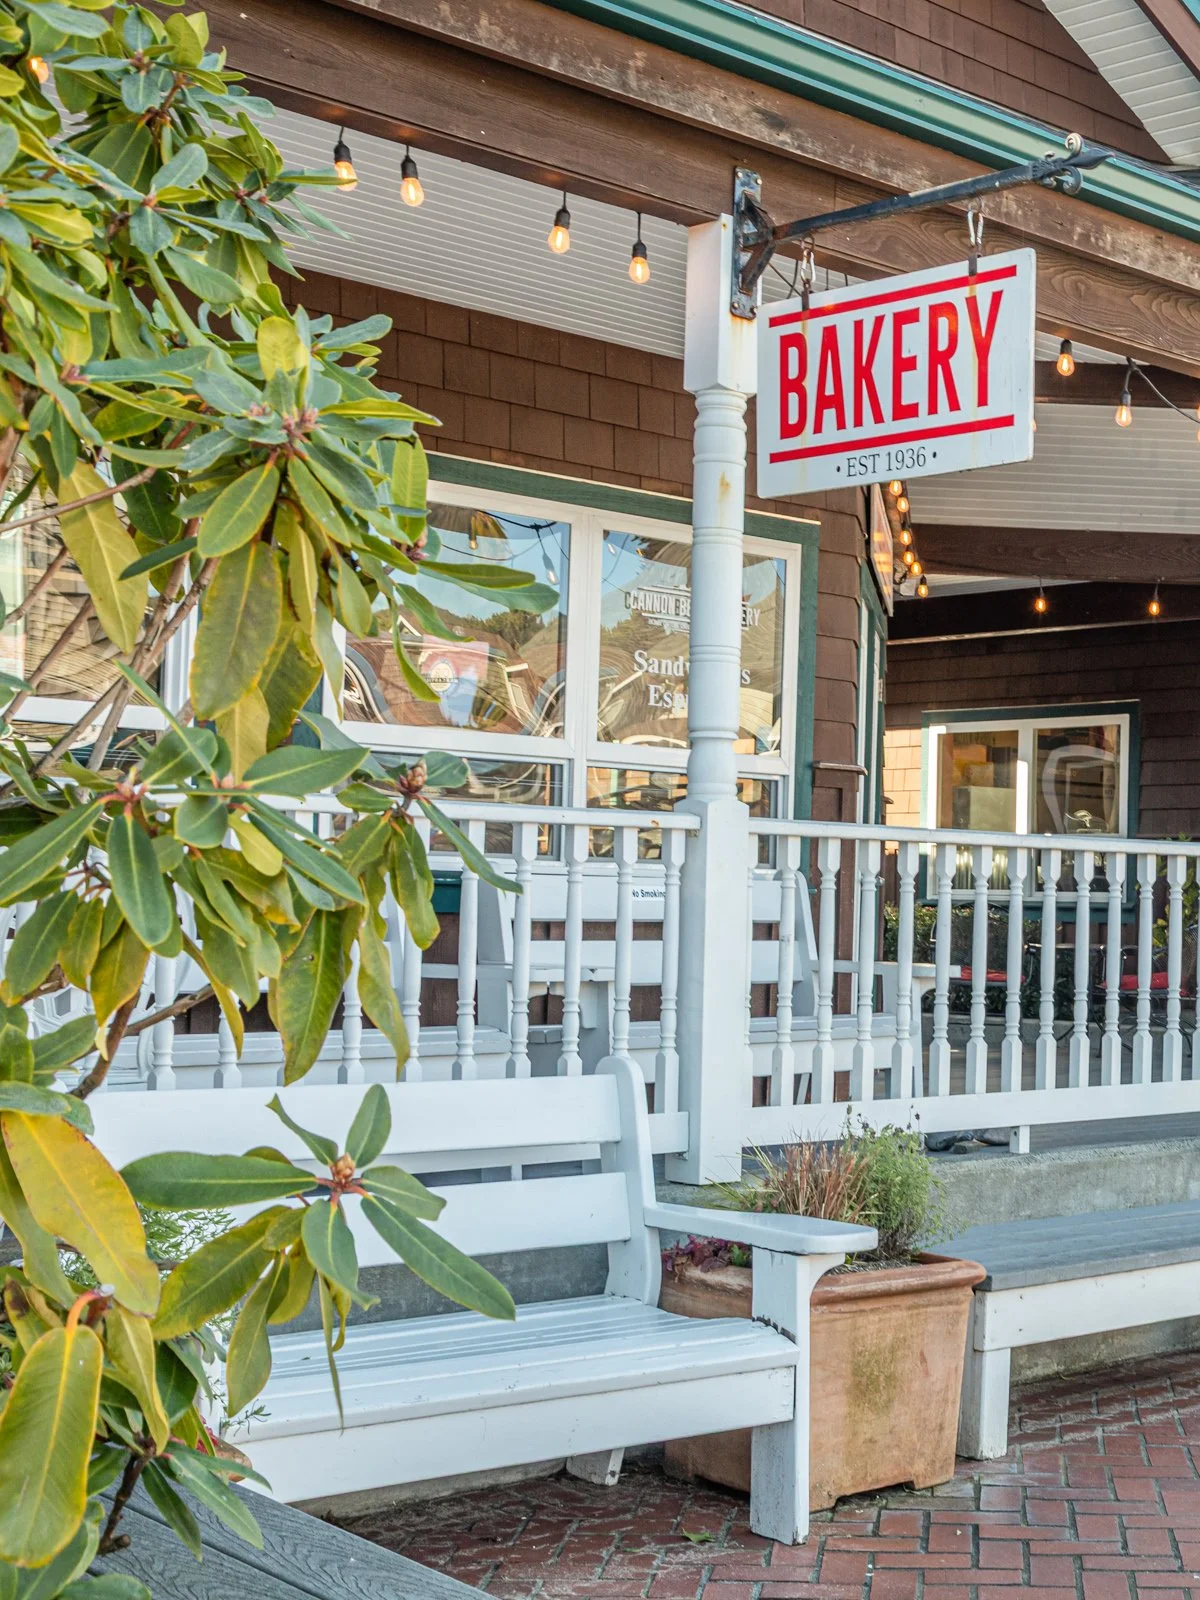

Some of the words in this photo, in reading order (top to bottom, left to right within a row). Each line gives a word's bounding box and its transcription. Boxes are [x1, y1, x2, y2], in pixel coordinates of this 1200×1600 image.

[780, 290, 1004, 440] BAKERY
[846, 453, 880, 477] EST
[886, 446, 927, 473] 1936
